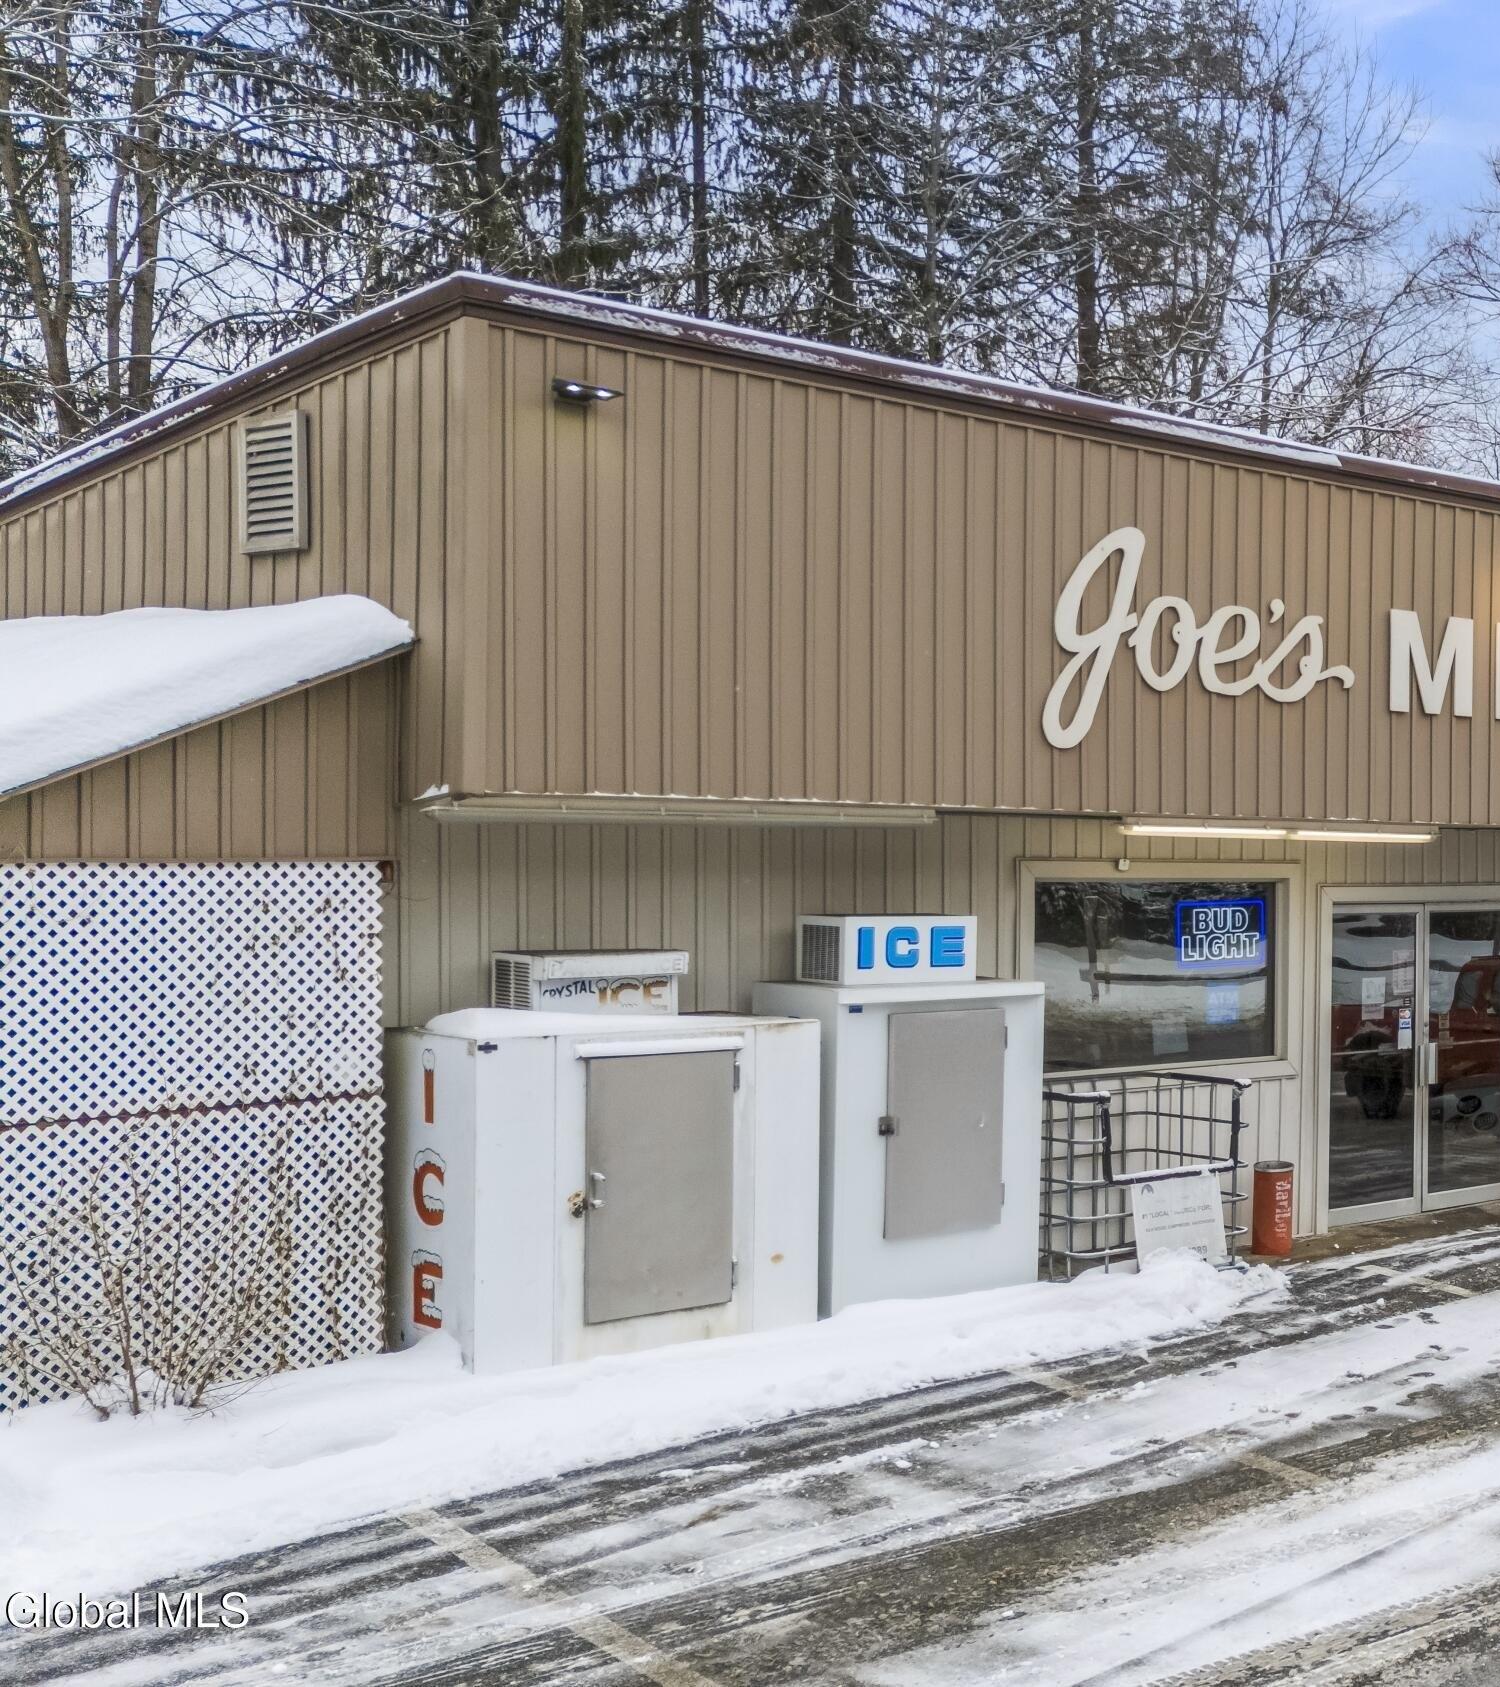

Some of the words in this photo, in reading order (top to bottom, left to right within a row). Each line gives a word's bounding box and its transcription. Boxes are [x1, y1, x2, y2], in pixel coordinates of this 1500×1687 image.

[1041, 526, 1355, 749] Joe's
[1192, 907, 1249, 934] BUD
[857, 926, 966, 970] ICE
[1181, 932, 1260, 961] LIGHT
[595, 975, 671, 1011] ICE
[411, 1048, 446, 1330] ICE
